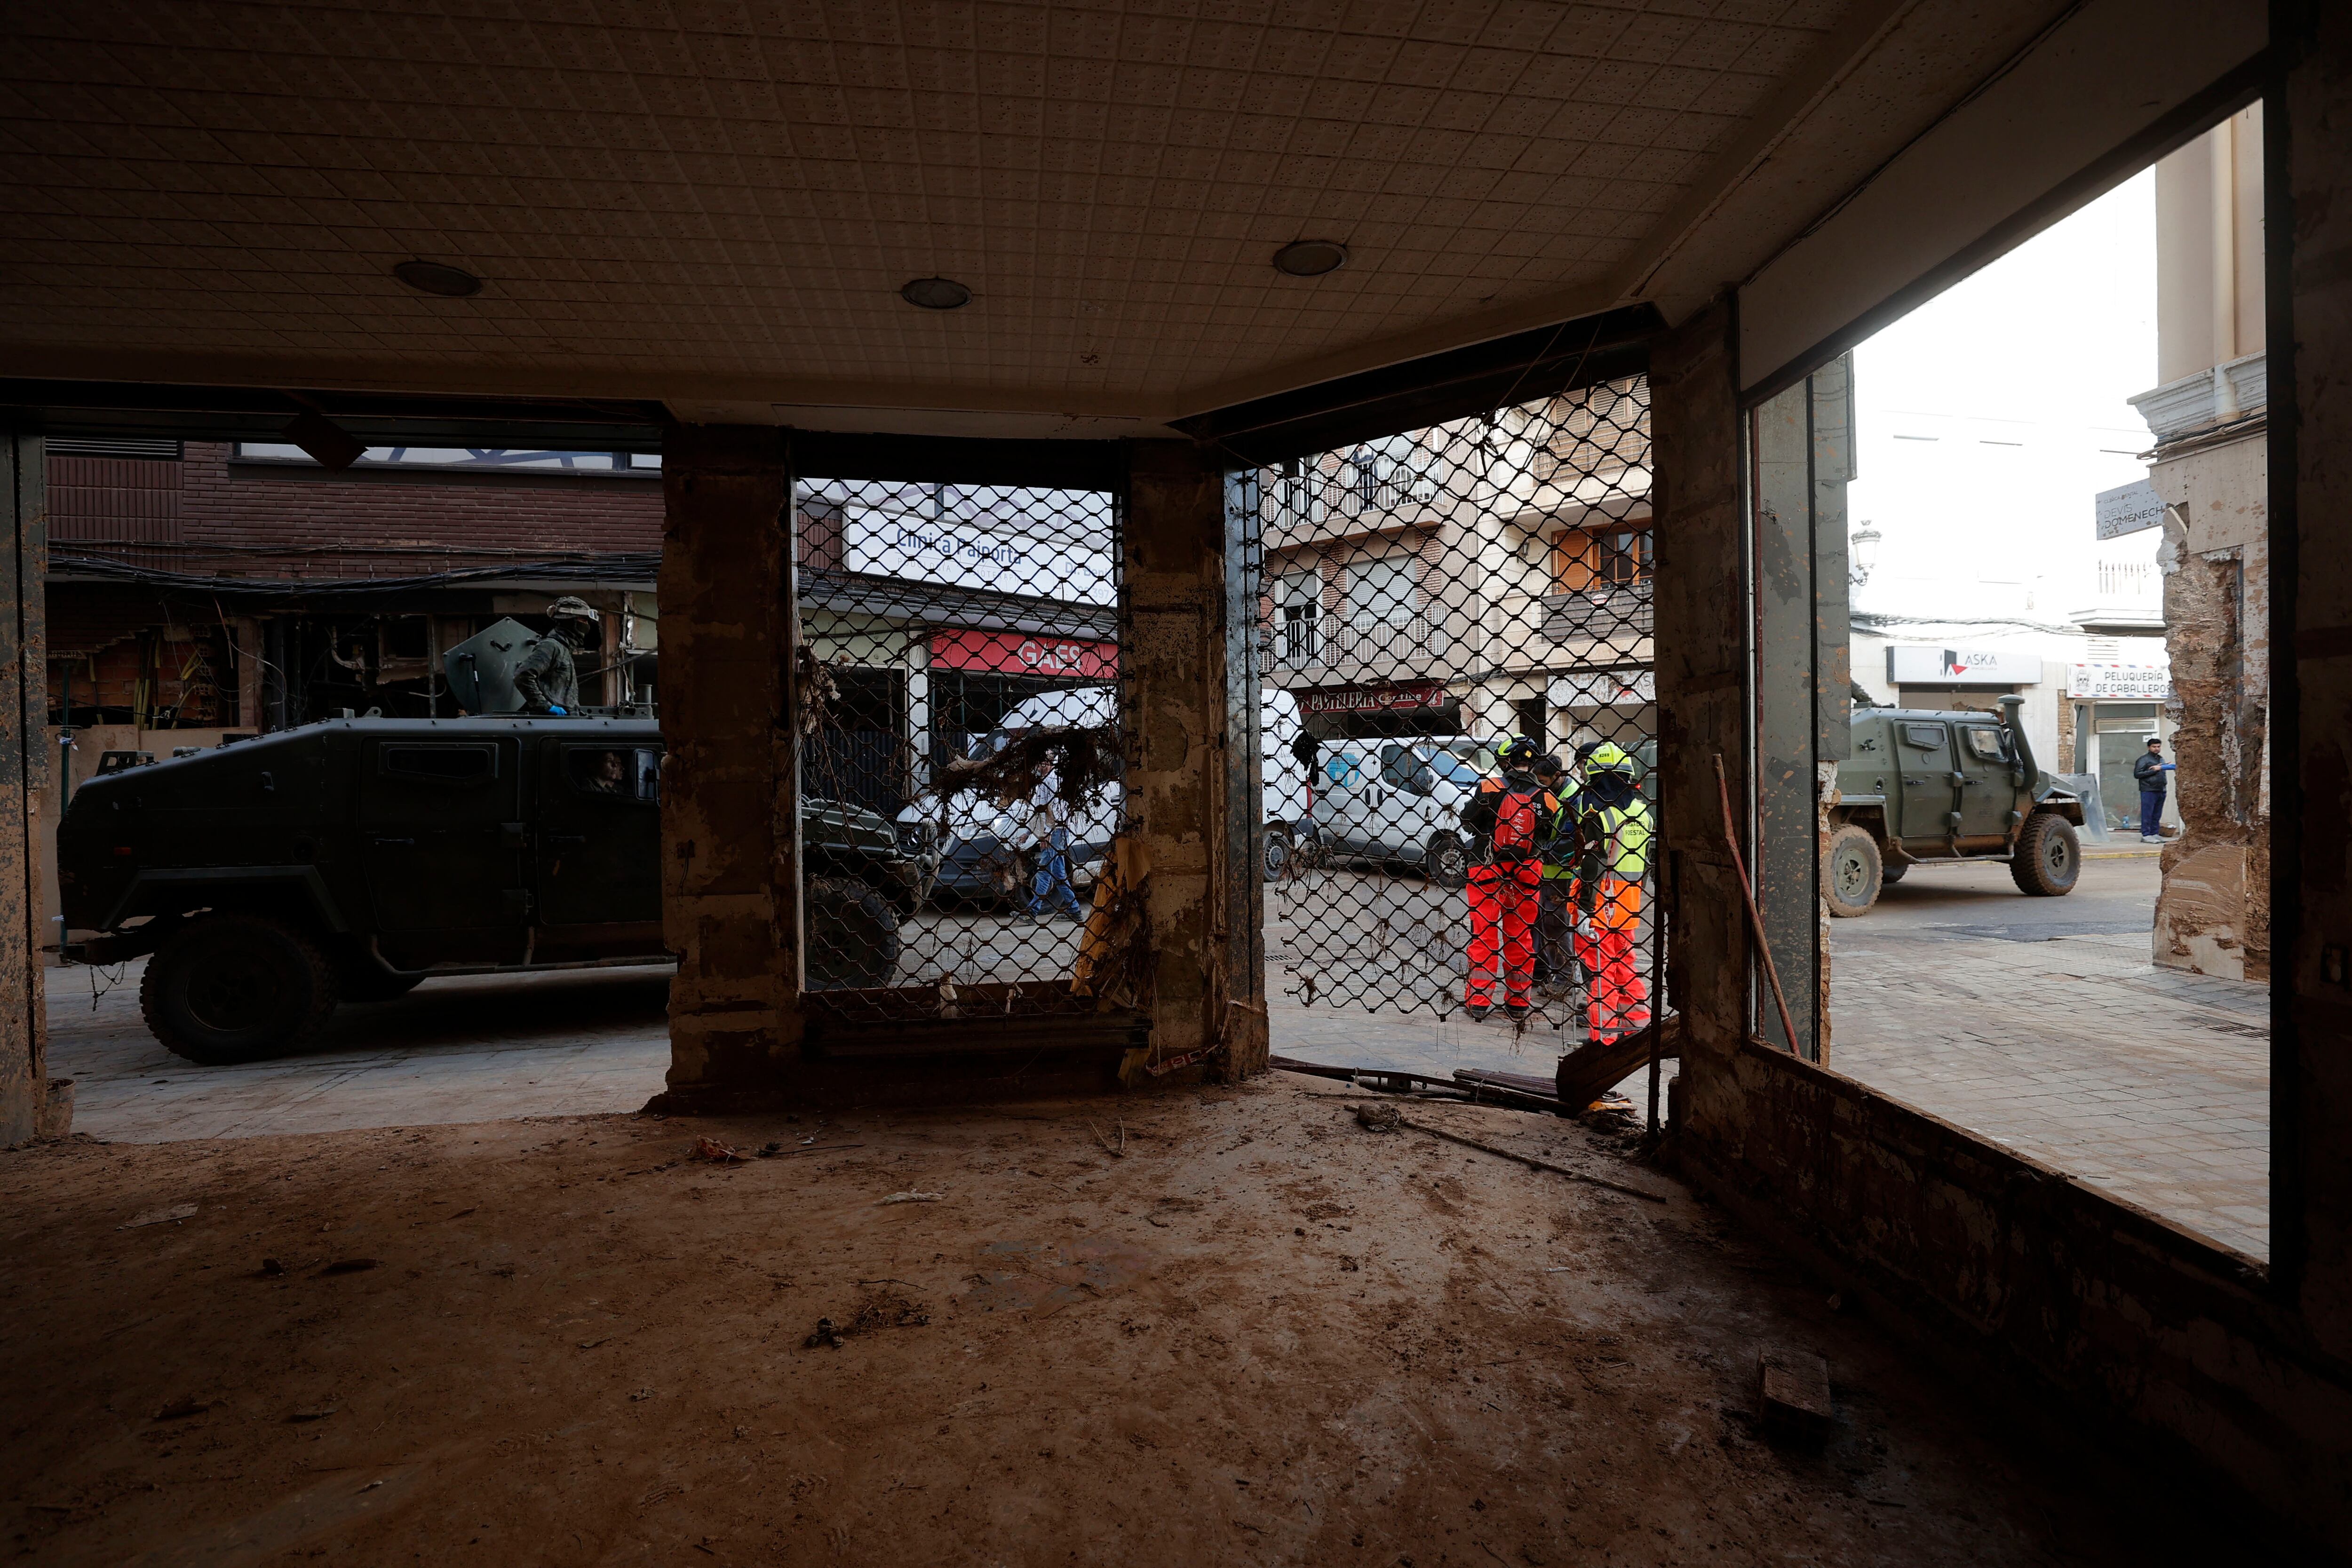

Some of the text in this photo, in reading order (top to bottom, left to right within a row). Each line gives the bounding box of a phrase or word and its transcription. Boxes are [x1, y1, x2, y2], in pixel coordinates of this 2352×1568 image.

[957, 538, 1021, 565] Paiporta
[1018, 641, 1081, 670] GAES
[1964, 654, 1998, 666] ASKA
[2105, 670, 2163, 681] PELUQUERÍA
[2096, 684, 2108, 692] DE
